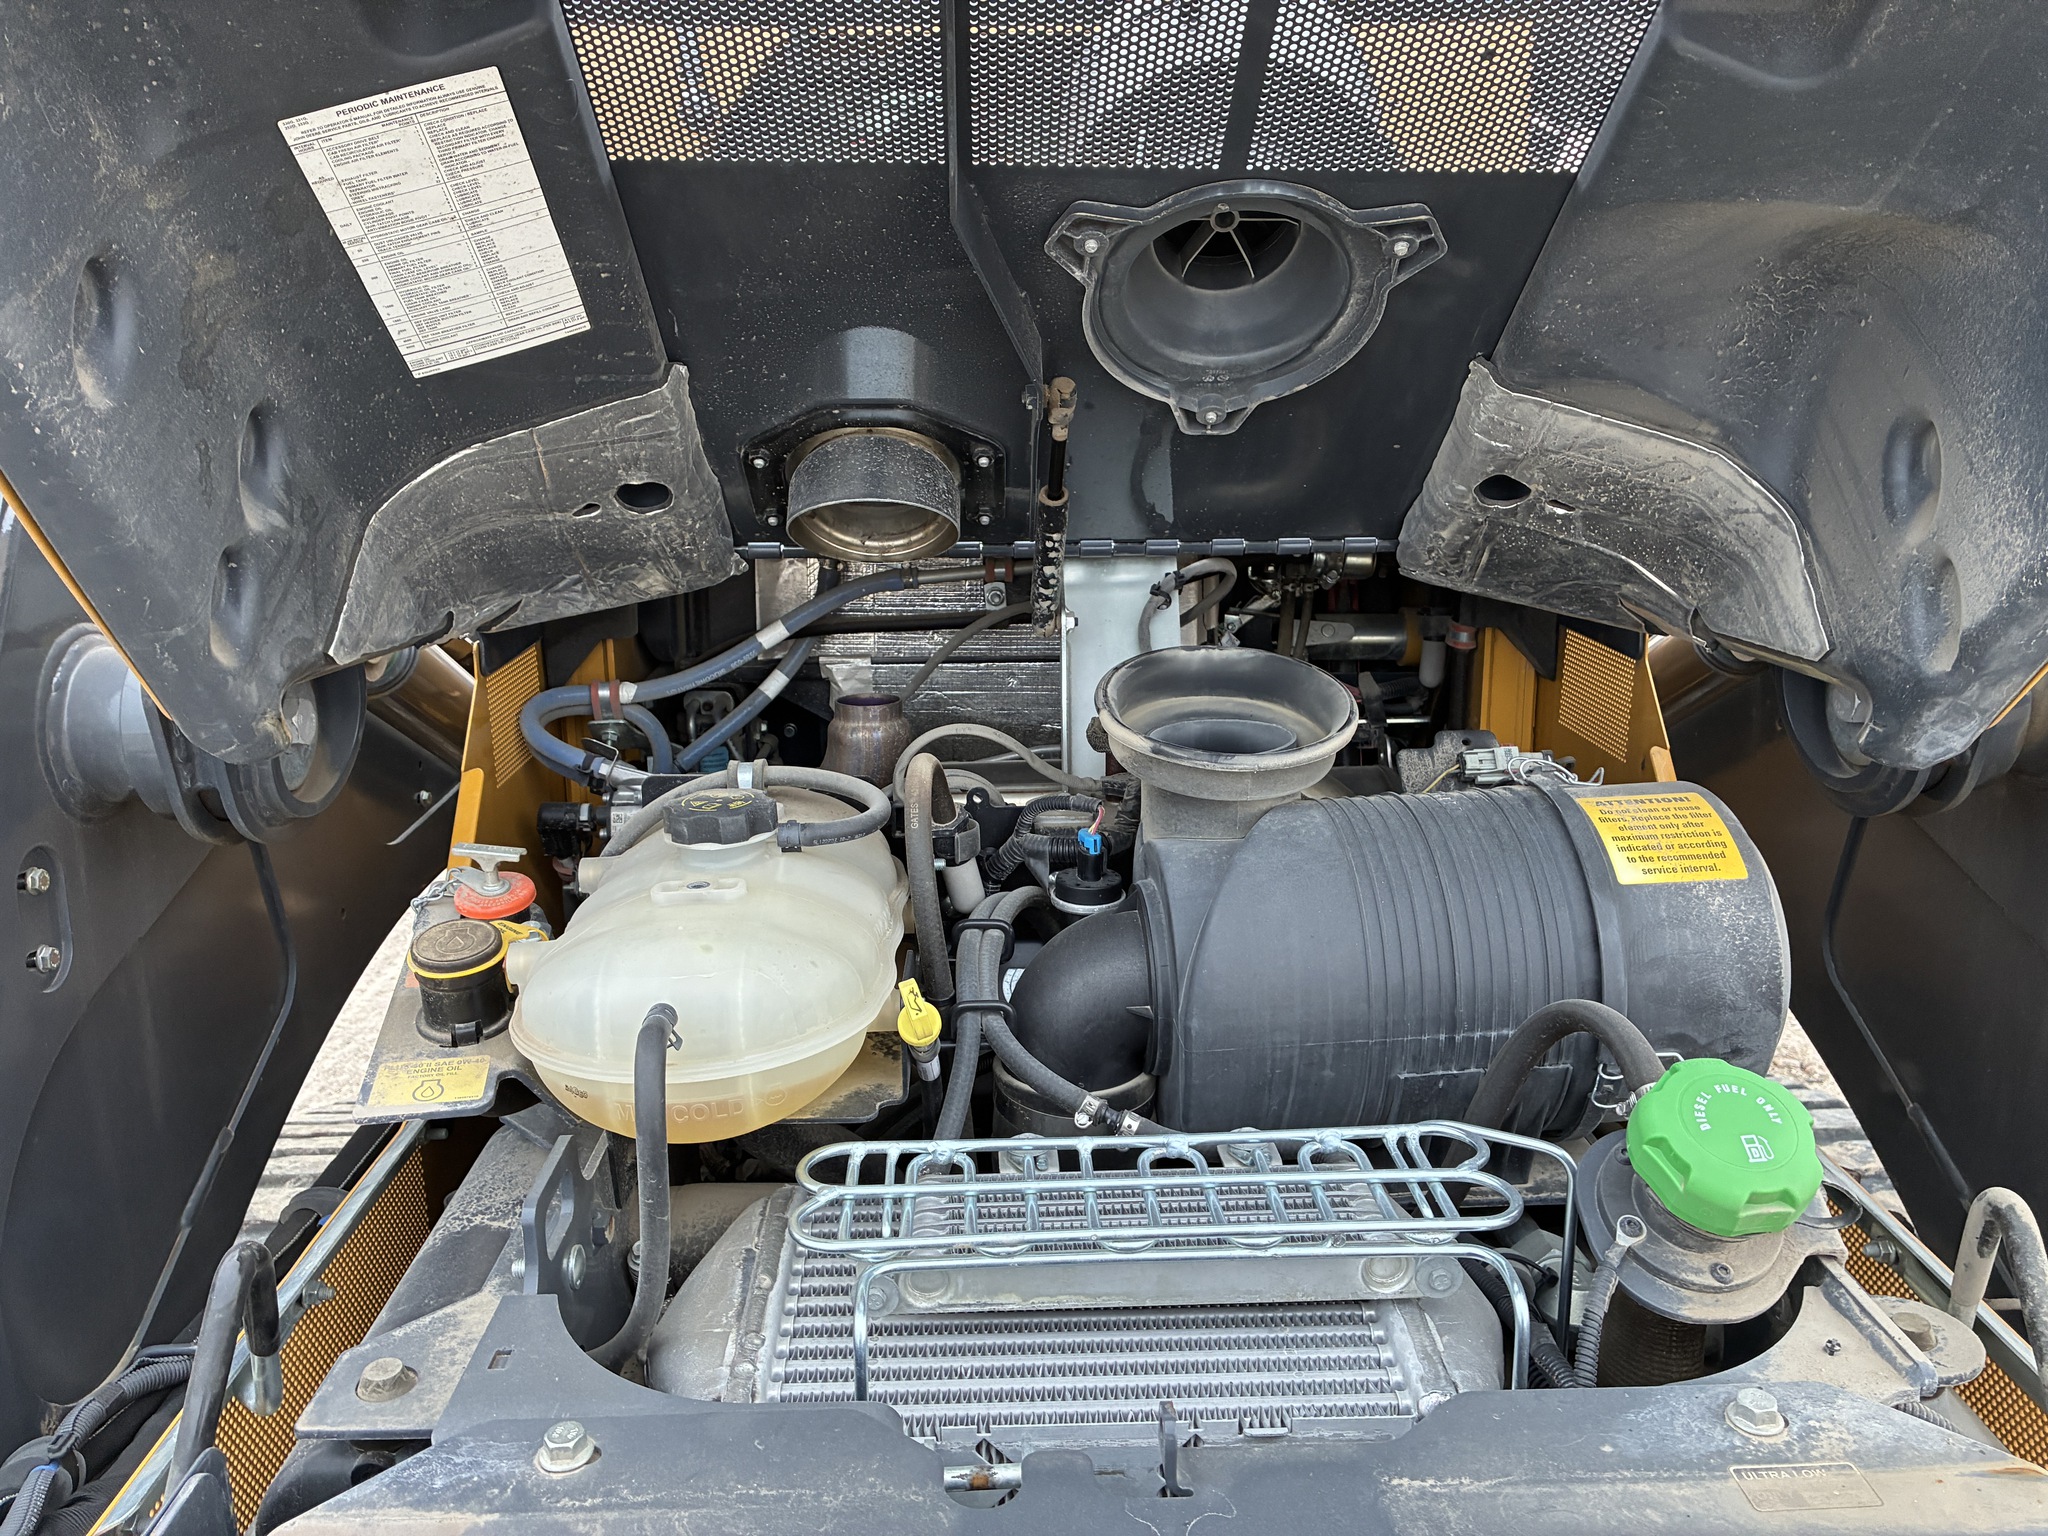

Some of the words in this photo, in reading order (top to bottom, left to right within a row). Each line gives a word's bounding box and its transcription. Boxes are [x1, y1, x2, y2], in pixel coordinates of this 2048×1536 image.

[334, 100, 379, 117] PERIODIC
[380, 84, 446, 106] MAINTENANCE
[382, 107, 412, 118] LUBRICANTS
[439, 92, 474, 103] RECOMMENDED
[474, 85, 498, 94] INTERVALS
[383, 104, 405, 112] DETAILED
[406, 96, 437, 107] INFORMATION
[419, 107, 449, 117] DESCRIPTION
[425, 122, 446, 130] REPLACE
[910, 803, 919, 829] GATES
[1632, 814, 1670, 823] Replace
[1619, 823, 1658, 831] element
[1660, 822, 1679, 830] only
[1612, 833, 1658, 842] maximum
[1661, 830, 1710, 839] restriction
[1616, 843, 1662, 852] indicated
[1678, 840, 1727, 850] according
[1657, 851, 1726, 862] recommended
[1642, 866, 1678, 875] service
[1681, 863, 1721, 873] interval.
[672, 1098, 745, 1124] COLD
[1694, 1091, 1713, 1131] DIESEL
[1714, 1084, 1747, 1096] FUEL
[1756, 1096, 1783, 1125] ONLY
[1741, 1470, 1790, 1480] ULTRA
